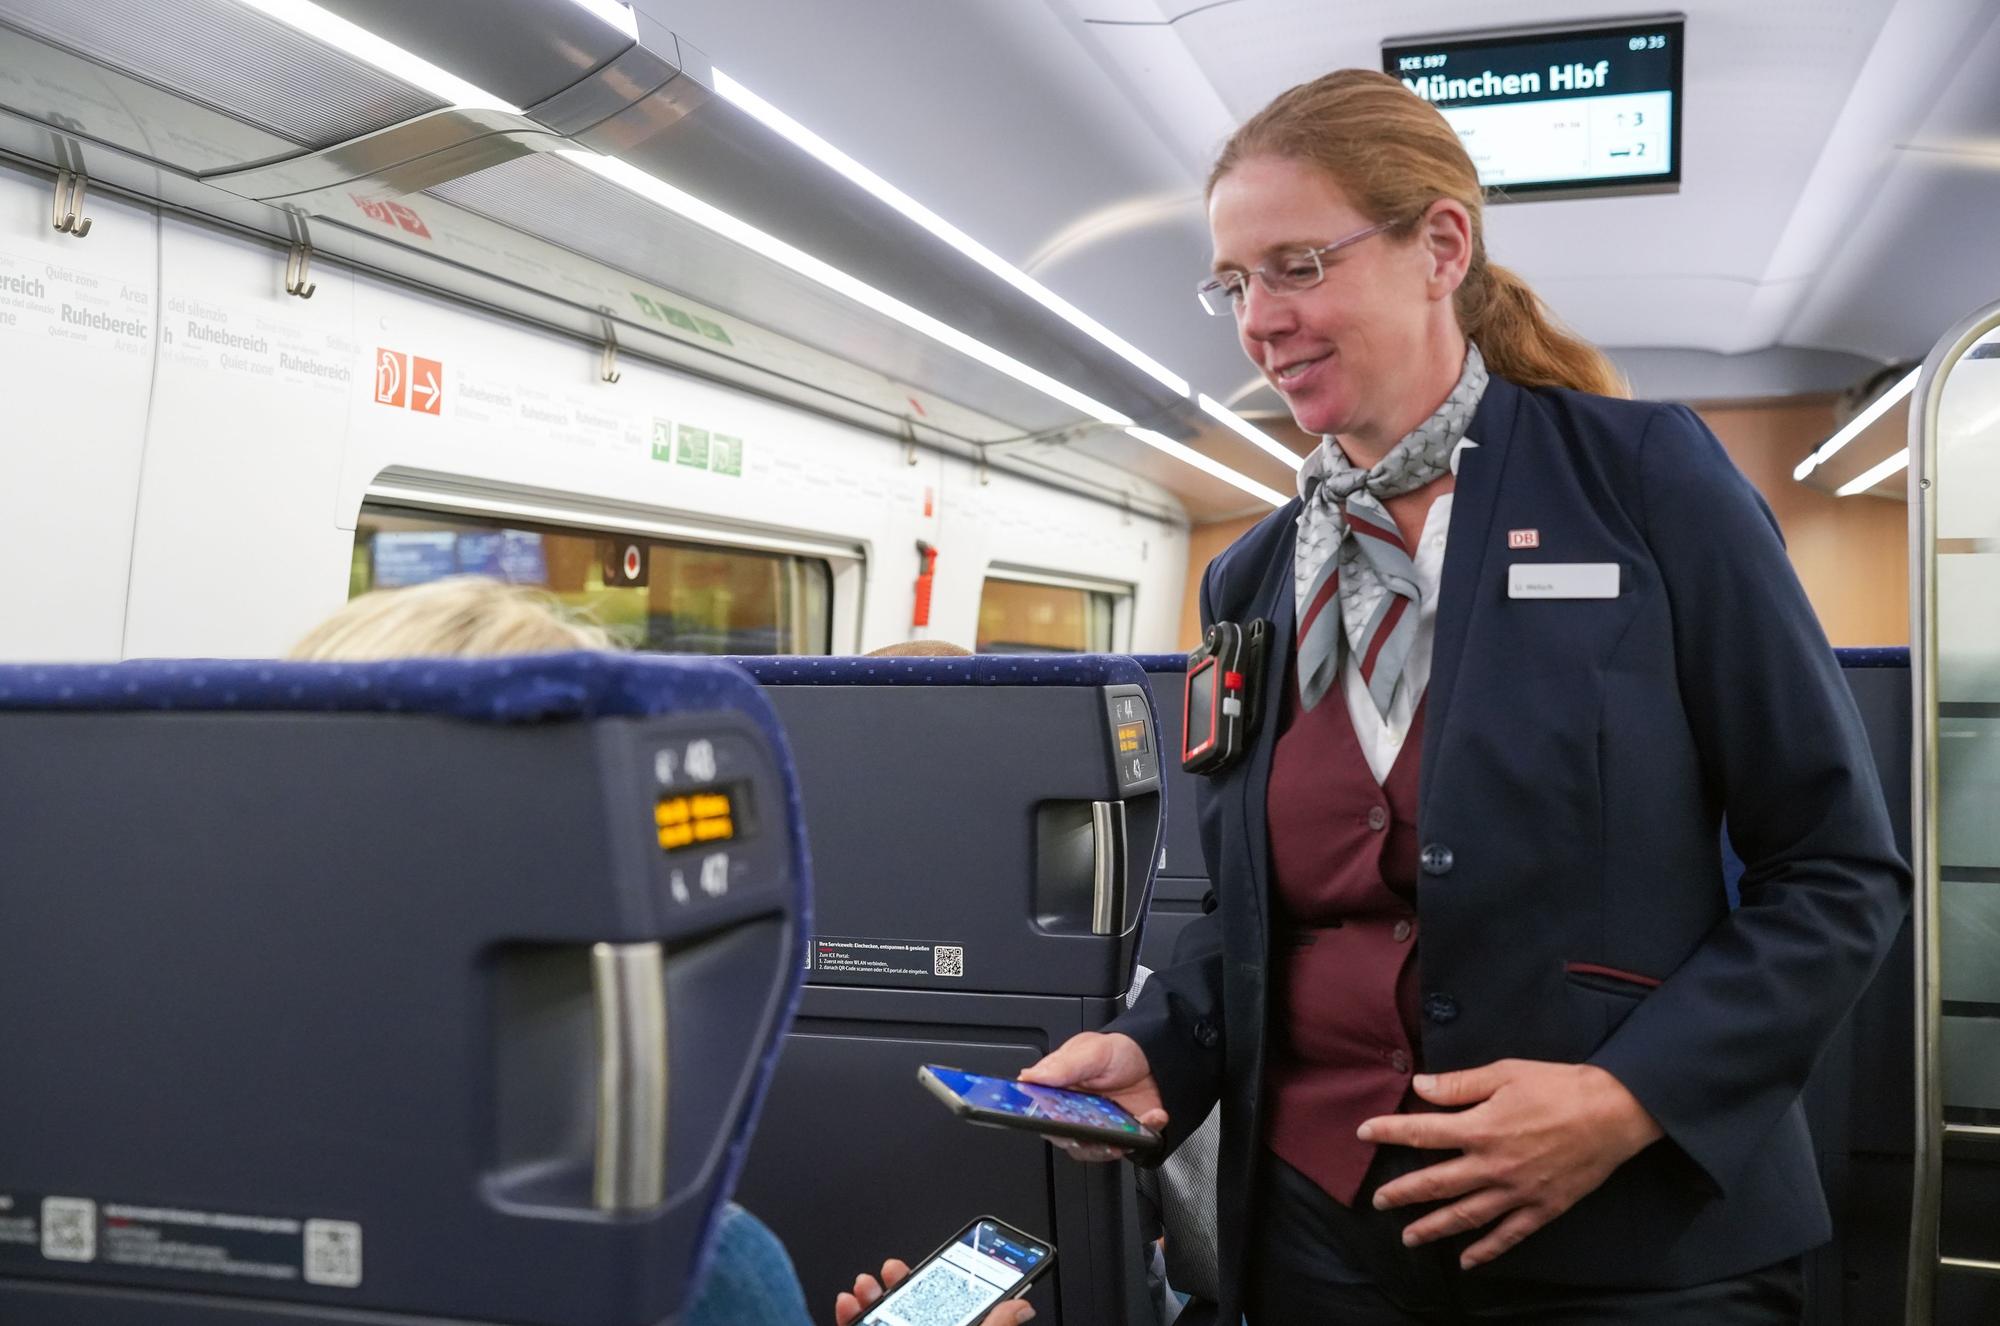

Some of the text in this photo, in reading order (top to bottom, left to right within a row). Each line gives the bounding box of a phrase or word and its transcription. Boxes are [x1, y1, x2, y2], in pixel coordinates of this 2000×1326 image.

[1399, 54, 1447, 70] ICE 597
[1401, 60, 1609, 101] München Hbf
[1634, 112, 1643, 126] 3
[1637, 142, 1645, 156] 2
[45, 265, 99, 289] Quiet zone
[120, 285, 148, 304] Area
[167, 297, 185, 314] del
[187, 302, 228, 324] silenzio
[48, 326, 70, 339] Quiet
[187, 321, 268, 355] Ruhebereich
[220, 353, 274, 377] Quiet zone
[279, 352, 351, 383] Ruhebereich
[1514, 533, 1533, 545] DB
